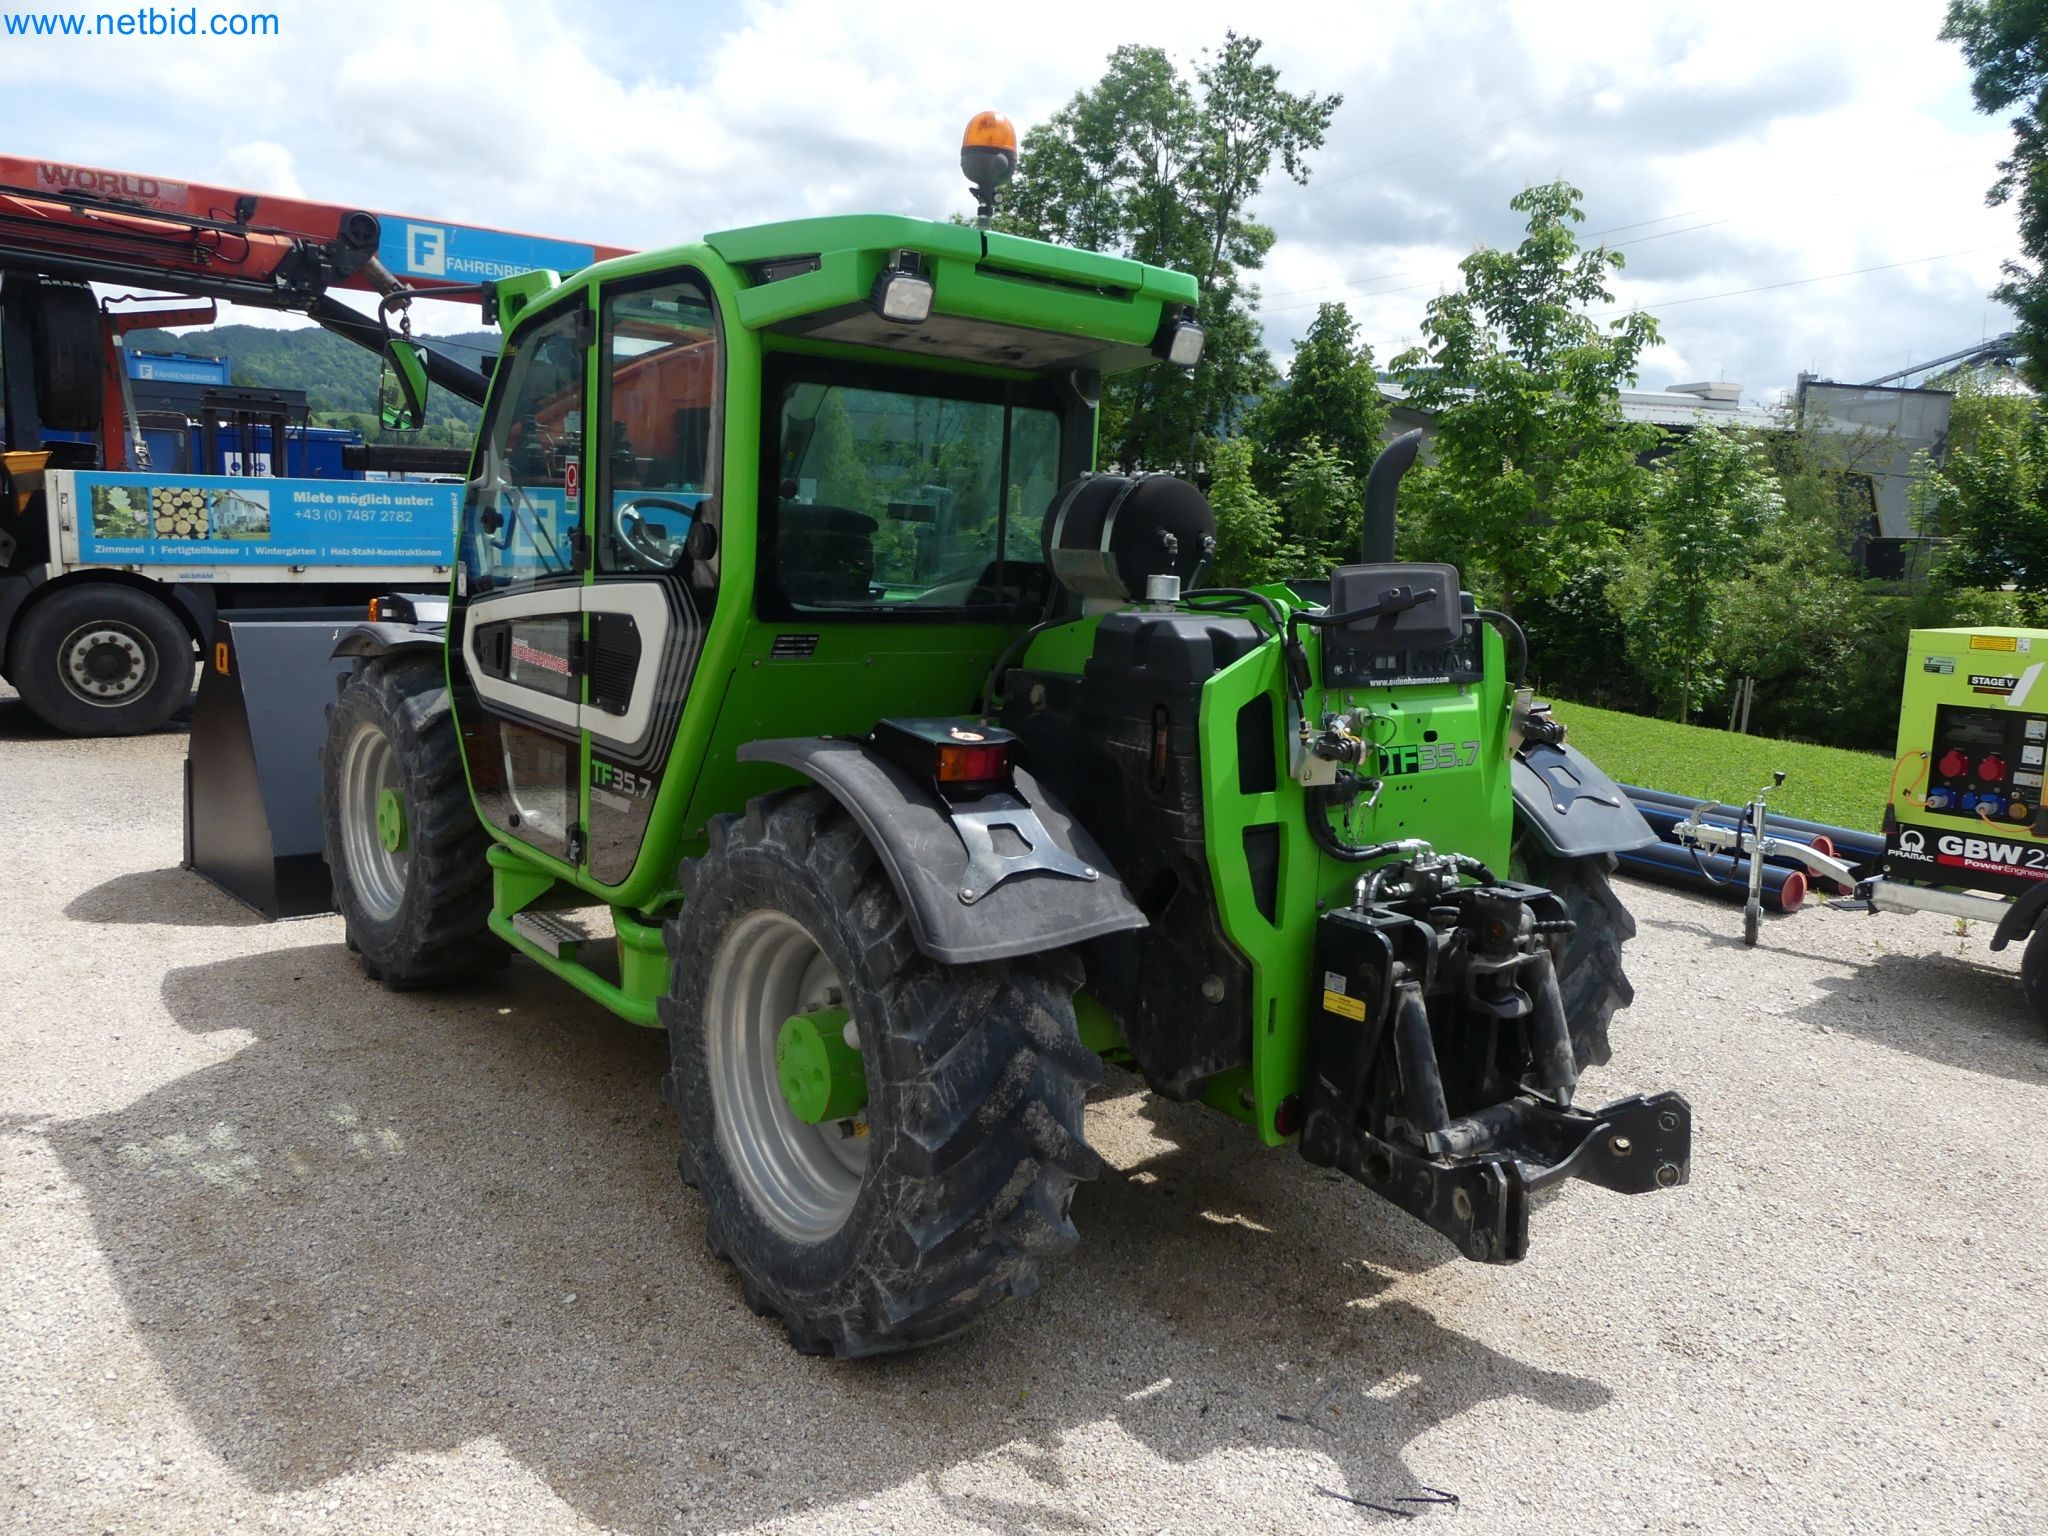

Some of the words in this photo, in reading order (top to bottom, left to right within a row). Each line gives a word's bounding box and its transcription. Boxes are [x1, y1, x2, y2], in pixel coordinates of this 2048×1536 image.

[39, 162, 161, 199] WORLD
[446, 257, 537, 278] FAHRENBER
[293, 491, 334, 503] Miete
[337, 492, 392, 506] möglich
[395, 494, 434, 506] unter:
[294, 508, 321, 520] +43
[324, 508, 342, 523] (0)
[345, 509, 376, 521] 7487
[380, 510, 413, 522] 2782
[94, 544, 145, 554] Zimmerei
[161, 545, 239, 556] Fertigteilhäuser
[255, 546, 316, 557] Wintergärten
[331, 547, 442, 557] Holz-Stahl-Konstruktionen
[1369, 675, 1450, 688] www.eidenhammer.com
[1971, 676, 2005, 687] STAGE
[2006, 679, 2014, 687] V
[1380, 741, 1480, 775] TF35.7
[591, 759, 652, 799] TF35.7
[1887, 849, 1935, 863] PRAMAC
[1938, 835, 2024, 865] GBW
[2025, 848, 2048, 871] 2
[1964, 858, 2048, 879] PowerEngineeri
